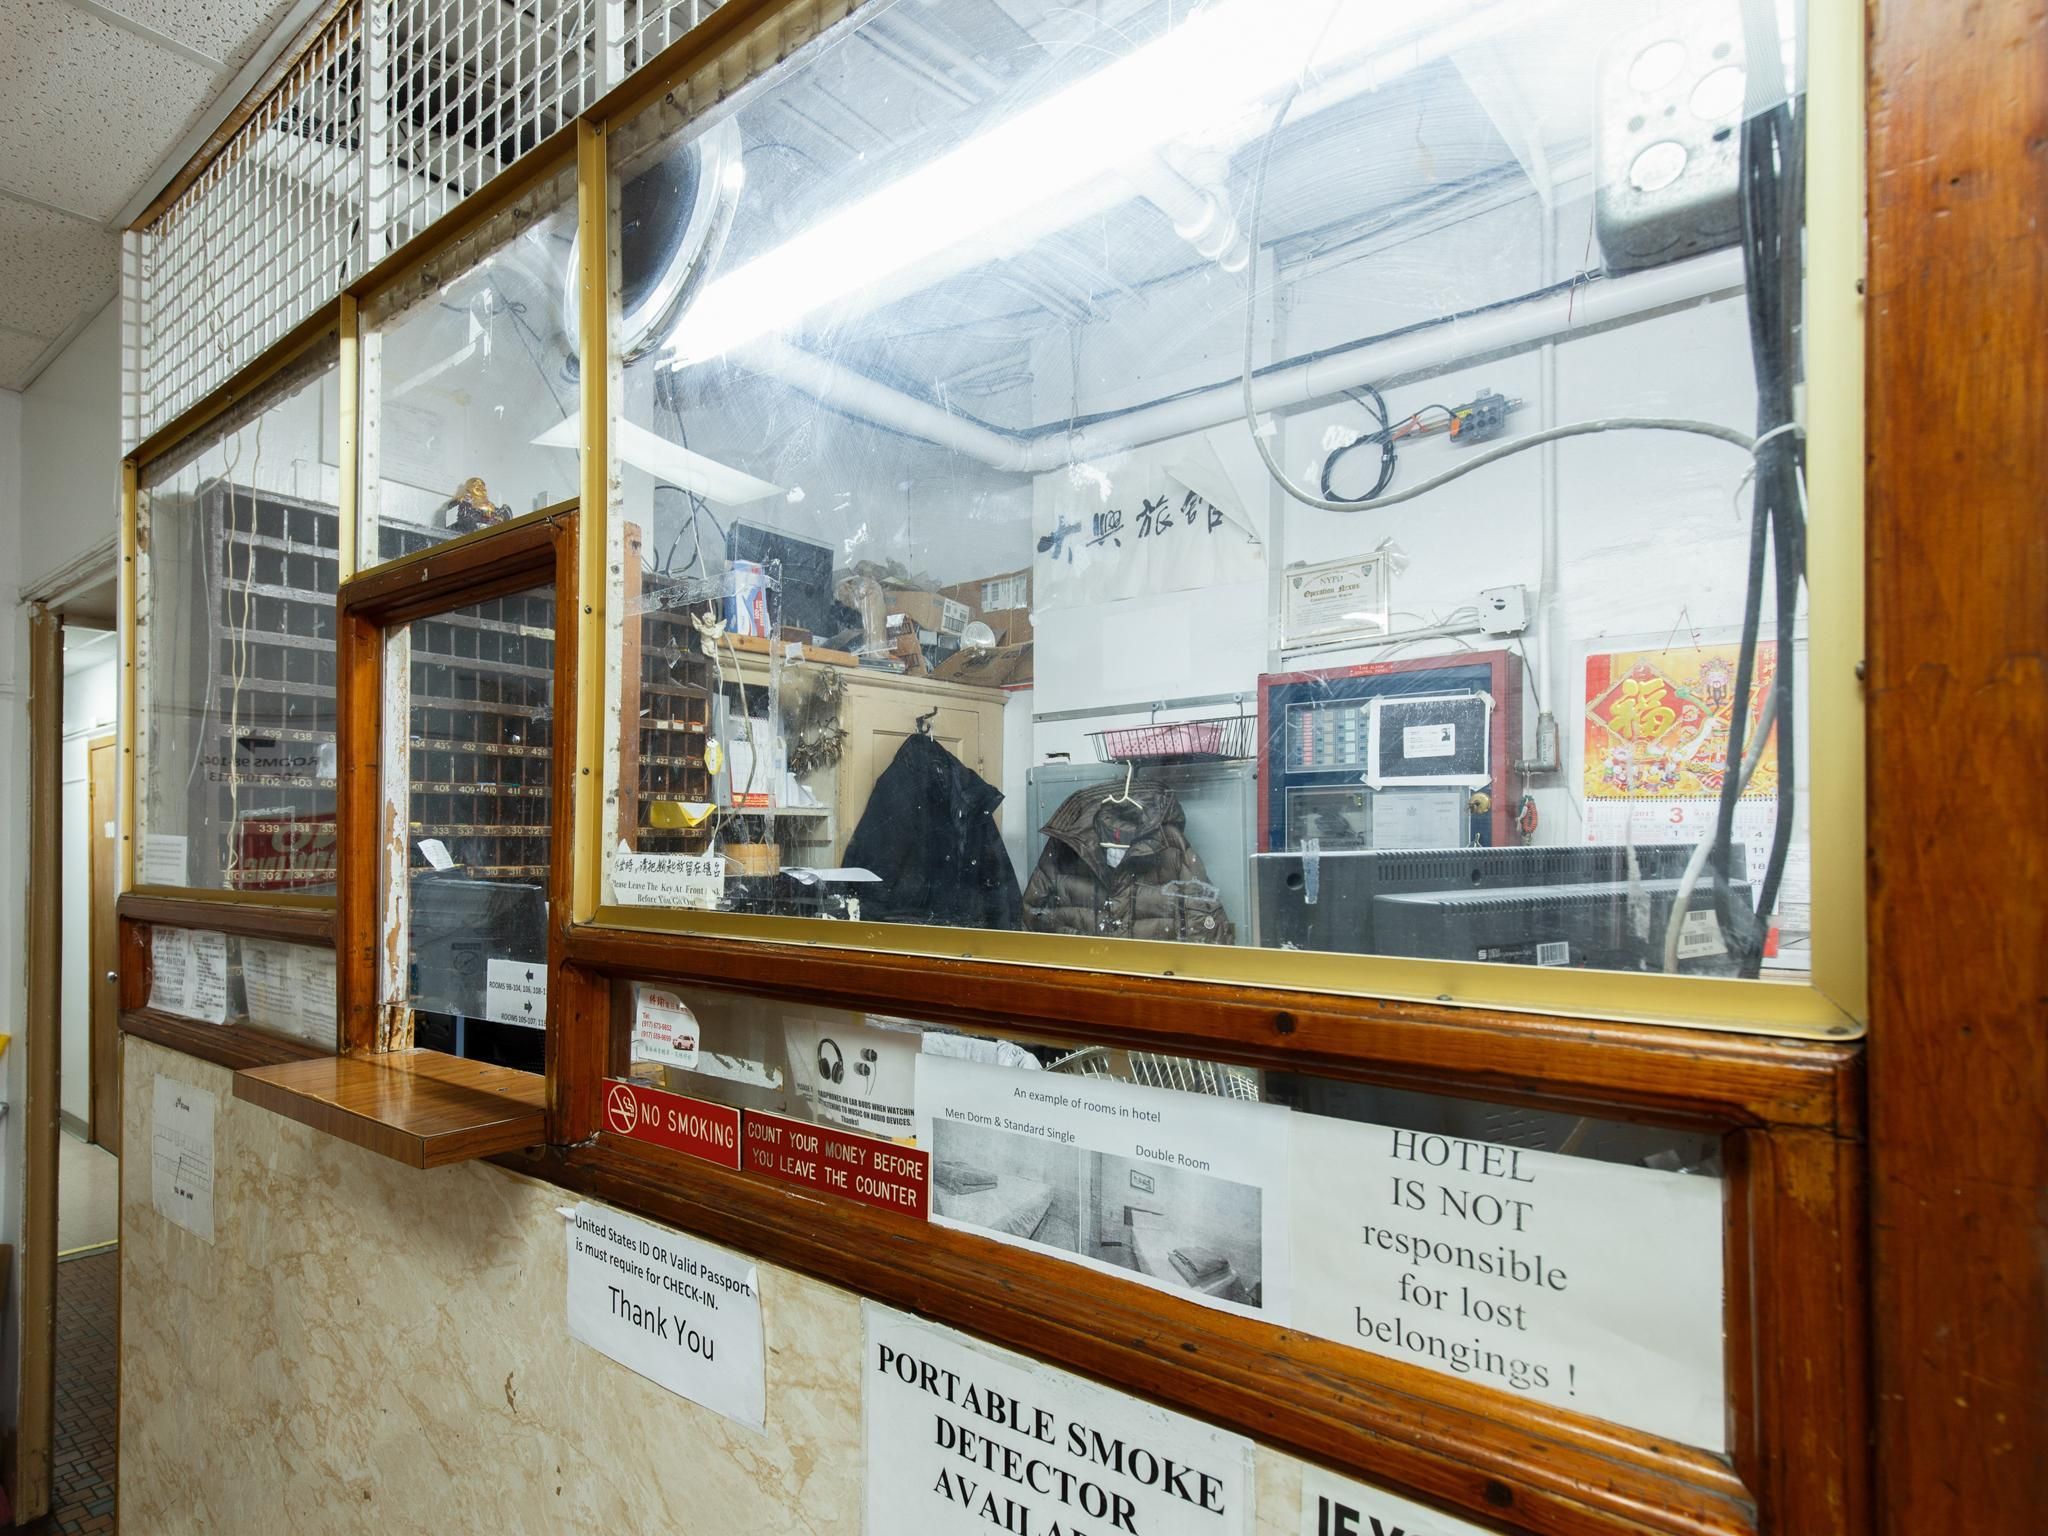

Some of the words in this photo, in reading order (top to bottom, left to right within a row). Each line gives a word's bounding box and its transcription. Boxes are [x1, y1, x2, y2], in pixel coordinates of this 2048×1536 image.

[1303, 588, 1335, 598] Operation
[1319, 576, 1344, 585] NYPD
[1608, 678, 1676, 739] 福
[292, 731, 313, 742] 438
[462, 743, 477, 752] 432
[507, 747, 524, 755] 430
[655, 756, 669, 766] 423
[291, 778, 313, 788] 403
[459, 785, 476, 794] 409
[507, 787, 521, 795] 411
[1669, 806, 1685, 824] 3
[258, 824, 280, 833] 339
[1754, 831, 1763, 839] 4
[628, 880, 646, 891] Leave
[647, 881, 659, 891] The
[661, 882, 673, 893] Key
[675, 883, 683, 893] At
[685, 884, 704, 895] Front
[637, 893, 656, 904] Before
[489, 981, 506, 990] ROOMS
[501, 1013, 518, 1023] ROOMS
[841, 1106, 848, 1114] TO
[848, 1108, 863, 1118] MUSIC
[871, 1113, 886, 1123] AUDIO
[886, 1116, 913, 1128] DEVICES.
[842, 1096, 849, 1104] OR
[849, 1098, 858, 1107] EAR
[872, 1104, 887, 1114] WHEN
[887, 1106, 915, 1117] WATCHIN
[1013, 1086, 1028, 1099] An
[1029, 1090, 1069, 1108] example
[1071, 1096, 1082, 1109] of
[1083, 1102, 1117, 1115] rooms
[1119, 1104, 1129, 1118] in
[1132, 1106, 1161, 1123] hotel
[640, 1102, 660, 1127] NO
[668, 1109, 734, 1150] SMOKING
[841, 1116, 860, 1126] Thanks!
[945, 1107, 967, 1121] Men
[967, 1111, 993, 1126] Dorm
[993, 1115, 1002, 1128] &
[1003, 1117, 1045, 1136] Standard
[1046, 1126, 1076, 1144] Single
[748, 1123, 783, 1146] COUNT
[789, 1131, 819, 1154] YOUR
[824, 1140, 867, 1166] MONEY
[873, 1151, 924, 1181] BEFORE
[1135, 1144, 1175, 1164] Double
[1177, 1153, 1210, 1172] Room
[1389, 1129, 1536, 1184] HOTEL
[752, 1147, 774, 1170] YOU
[779, 1153, 817, 1181] LEAVE
[824, 1166, 848, 1189] THE
[855, 1175, 917, 1209] COUNTER
[1391, 1176, 1426, 1211] IS
[1439, 1185, 1534, 1233] NOT
[575, 1213, 607, 1240] United
[608, 1226, 638, 1252] States
[639, 1239, 651, 1257] ID
[652, 1245, 668, 1266] OR
[670, 1251, 698, 1277] Valid
[700, 1264, 751, 1298] Passport
[1362, 1223, 1568, 1292] responsible
[575, 1236, 584, 1252] is
[585, 1244, 608, 1264] must
[609, 1254, 644, 1280] require
[646, 1267, 662, 1287] for
[663, 1275, 719, 1311] CHECK-IN.
[1398, 1272, 1449, 1312] for
[1461, 1286, 1529, 1332] lost
[608, 1285, 669, 1341] Thank
[674, 1314, 715, 1362] You
[1354, 1305, 1550, 1391] belongings
[876, 1342, 1056, 1446] PORTABLE
[1066, 1421, 1226, 1516] SMOKE
[933, 1413, 1139, 1536] DETECTOR
